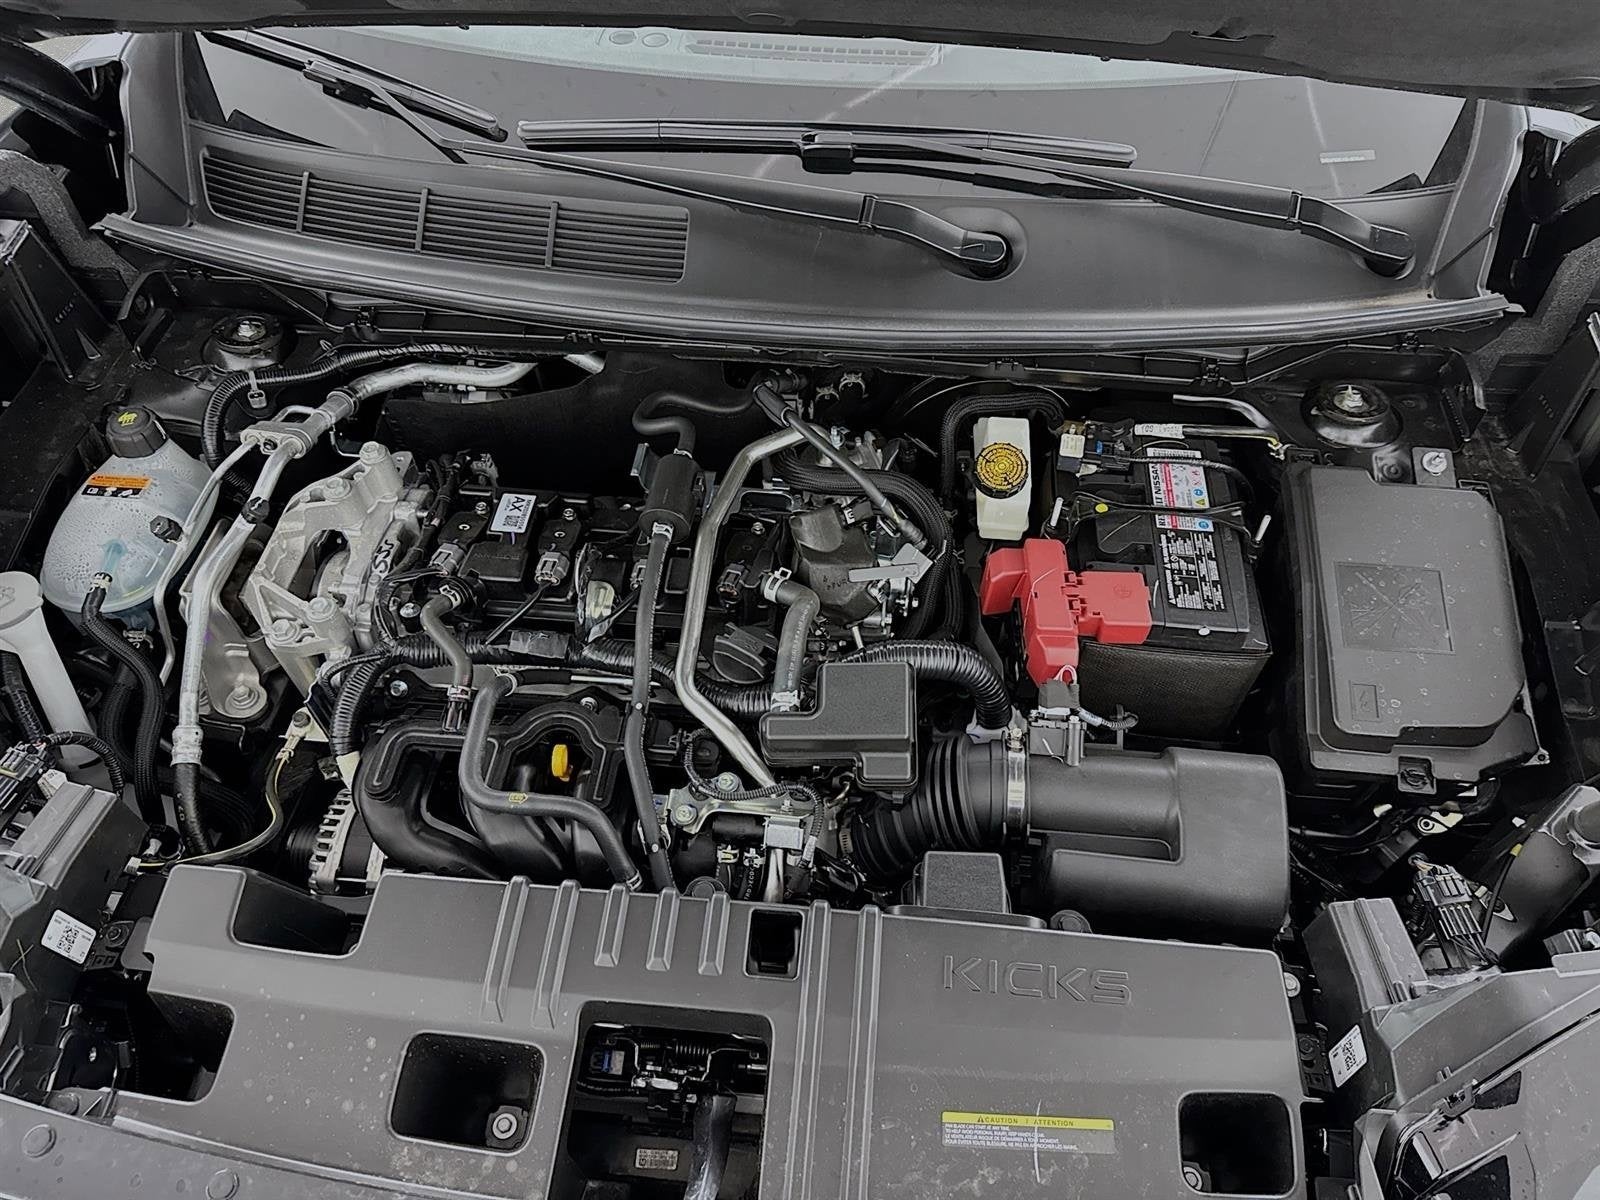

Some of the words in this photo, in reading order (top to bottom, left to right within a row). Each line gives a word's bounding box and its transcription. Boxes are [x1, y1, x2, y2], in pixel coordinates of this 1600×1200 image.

[509, 496, 526, 512] AX
[943, 955, 1132, 1005] KICKS
[1034, 1119, 1074, 1127] ATTENTION
